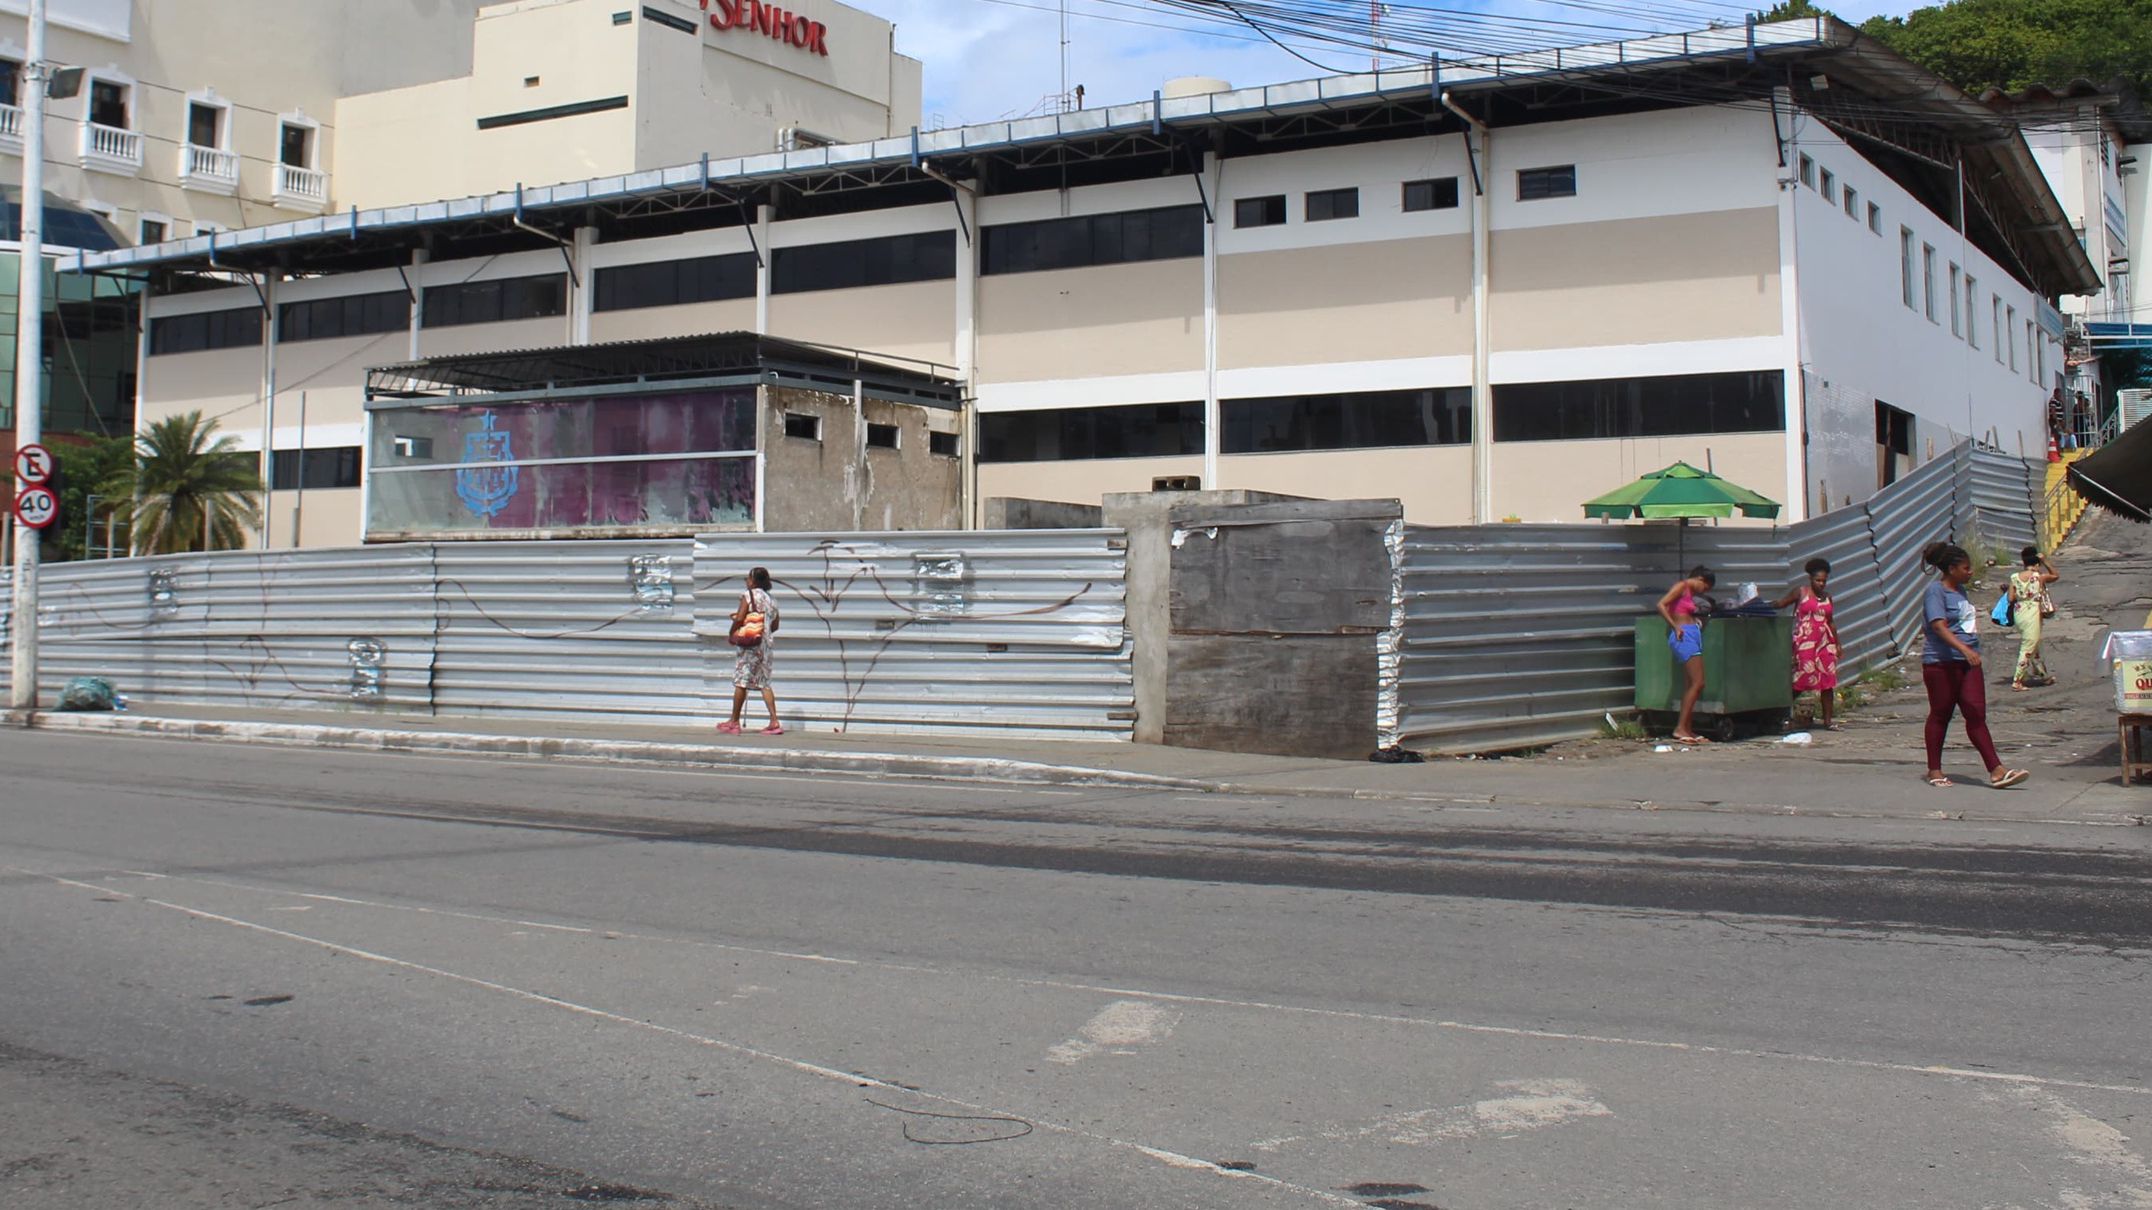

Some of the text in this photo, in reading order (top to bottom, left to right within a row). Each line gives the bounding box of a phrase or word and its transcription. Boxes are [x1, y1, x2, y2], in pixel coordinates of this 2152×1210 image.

[710, 0, 828, 57] SENHOR
[27, 453, 41, 476] E
[20, 495, 51, 513] 40
